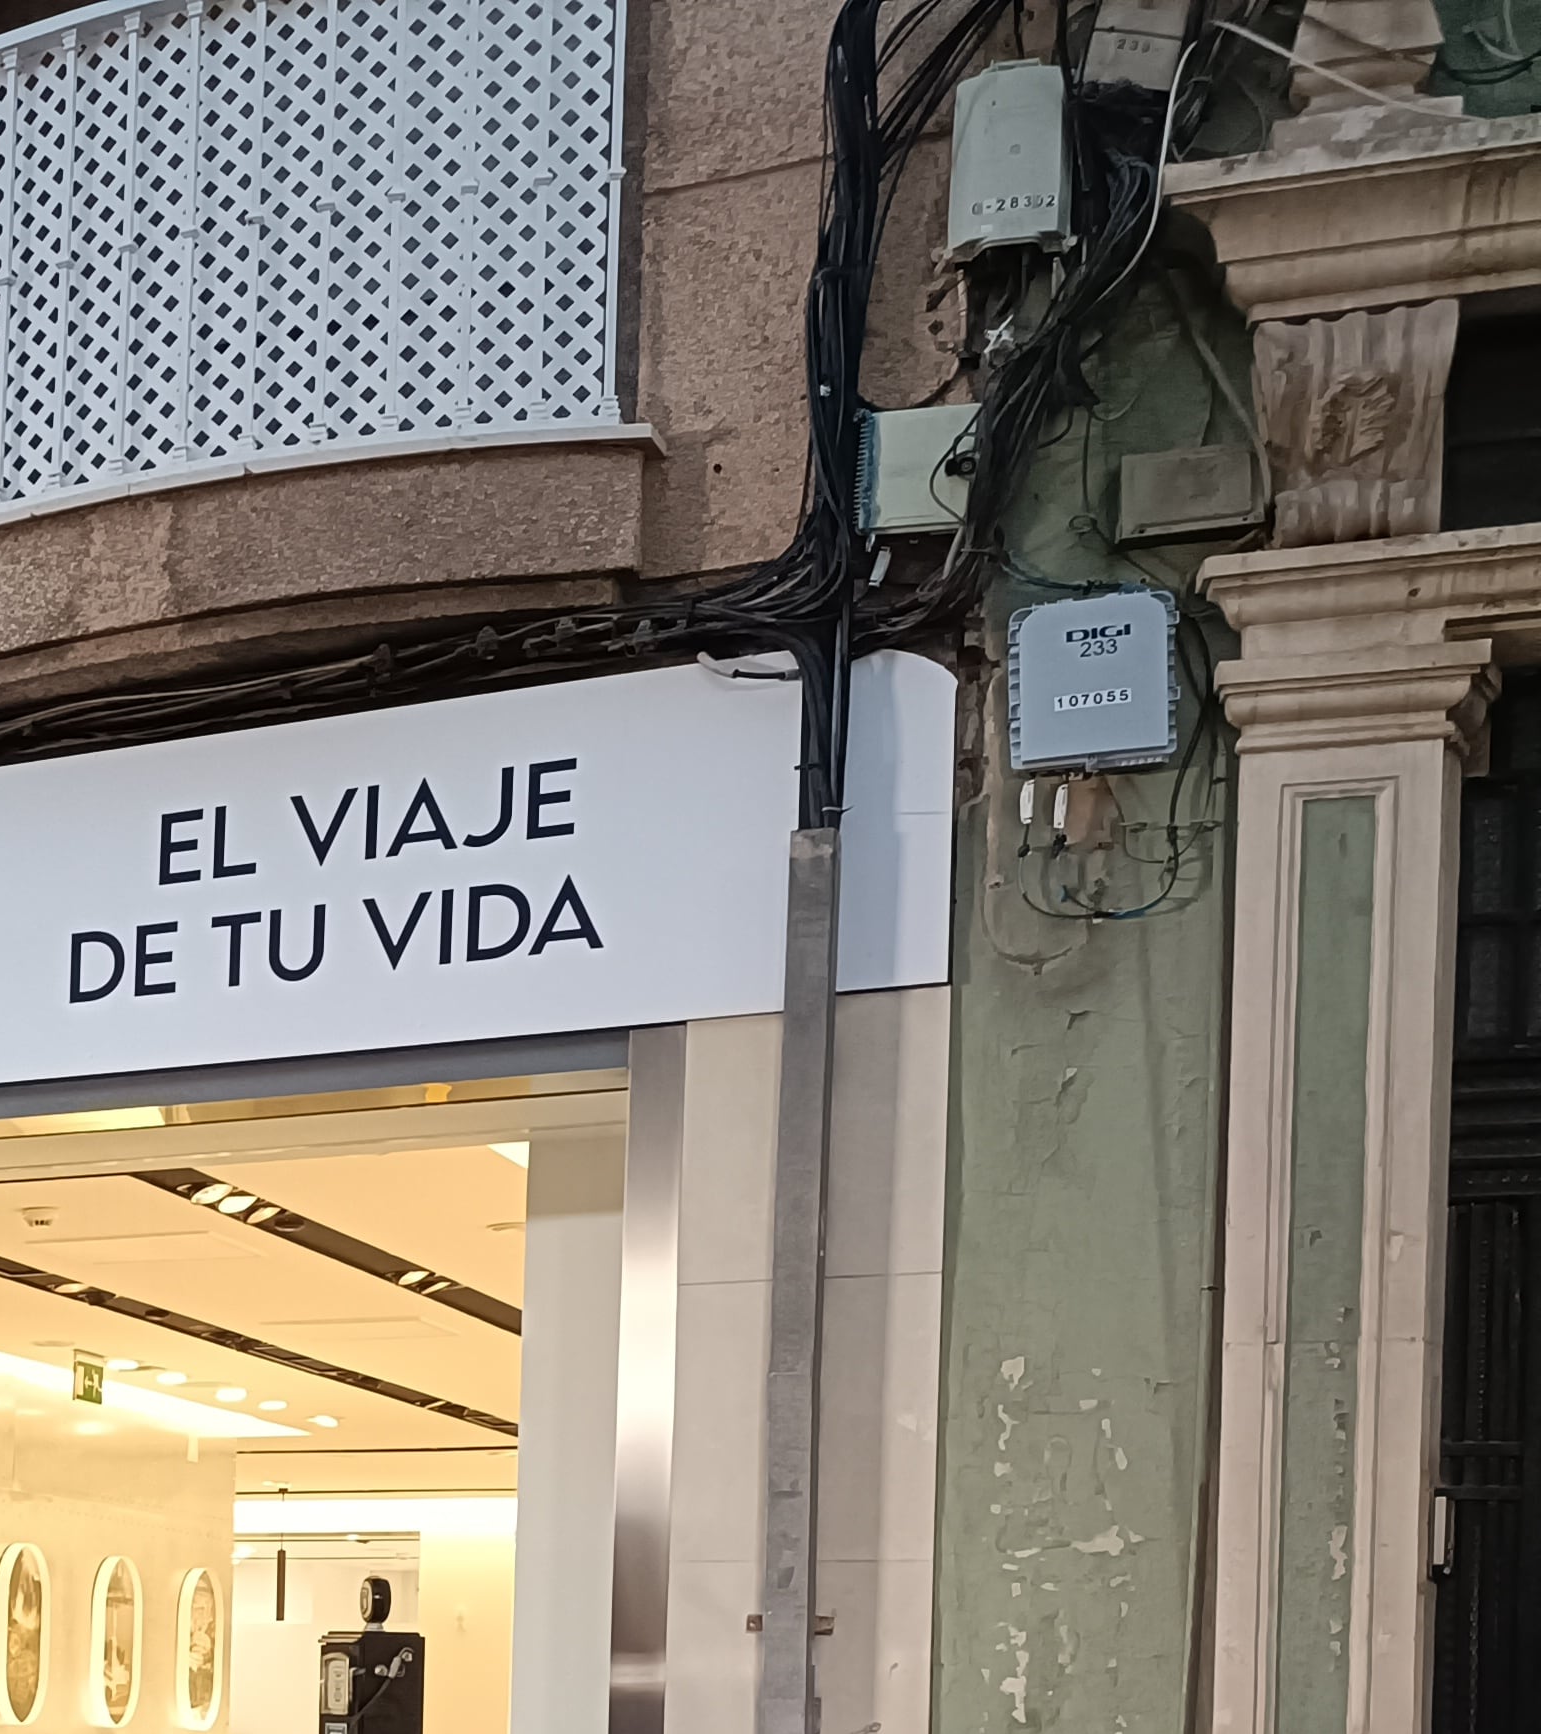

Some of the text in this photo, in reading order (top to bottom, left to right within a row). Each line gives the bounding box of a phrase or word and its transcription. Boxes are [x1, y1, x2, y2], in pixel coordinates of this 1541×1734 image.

[1066, 623, 1132, 643] DIGI
[1079, 638, 1119, 658] 233
[1057, 689, 1129, 709] 107055
[158, 757, 578, 886] EL VIAJE
[69, 873, 605, 1004] DE TU VIDA
